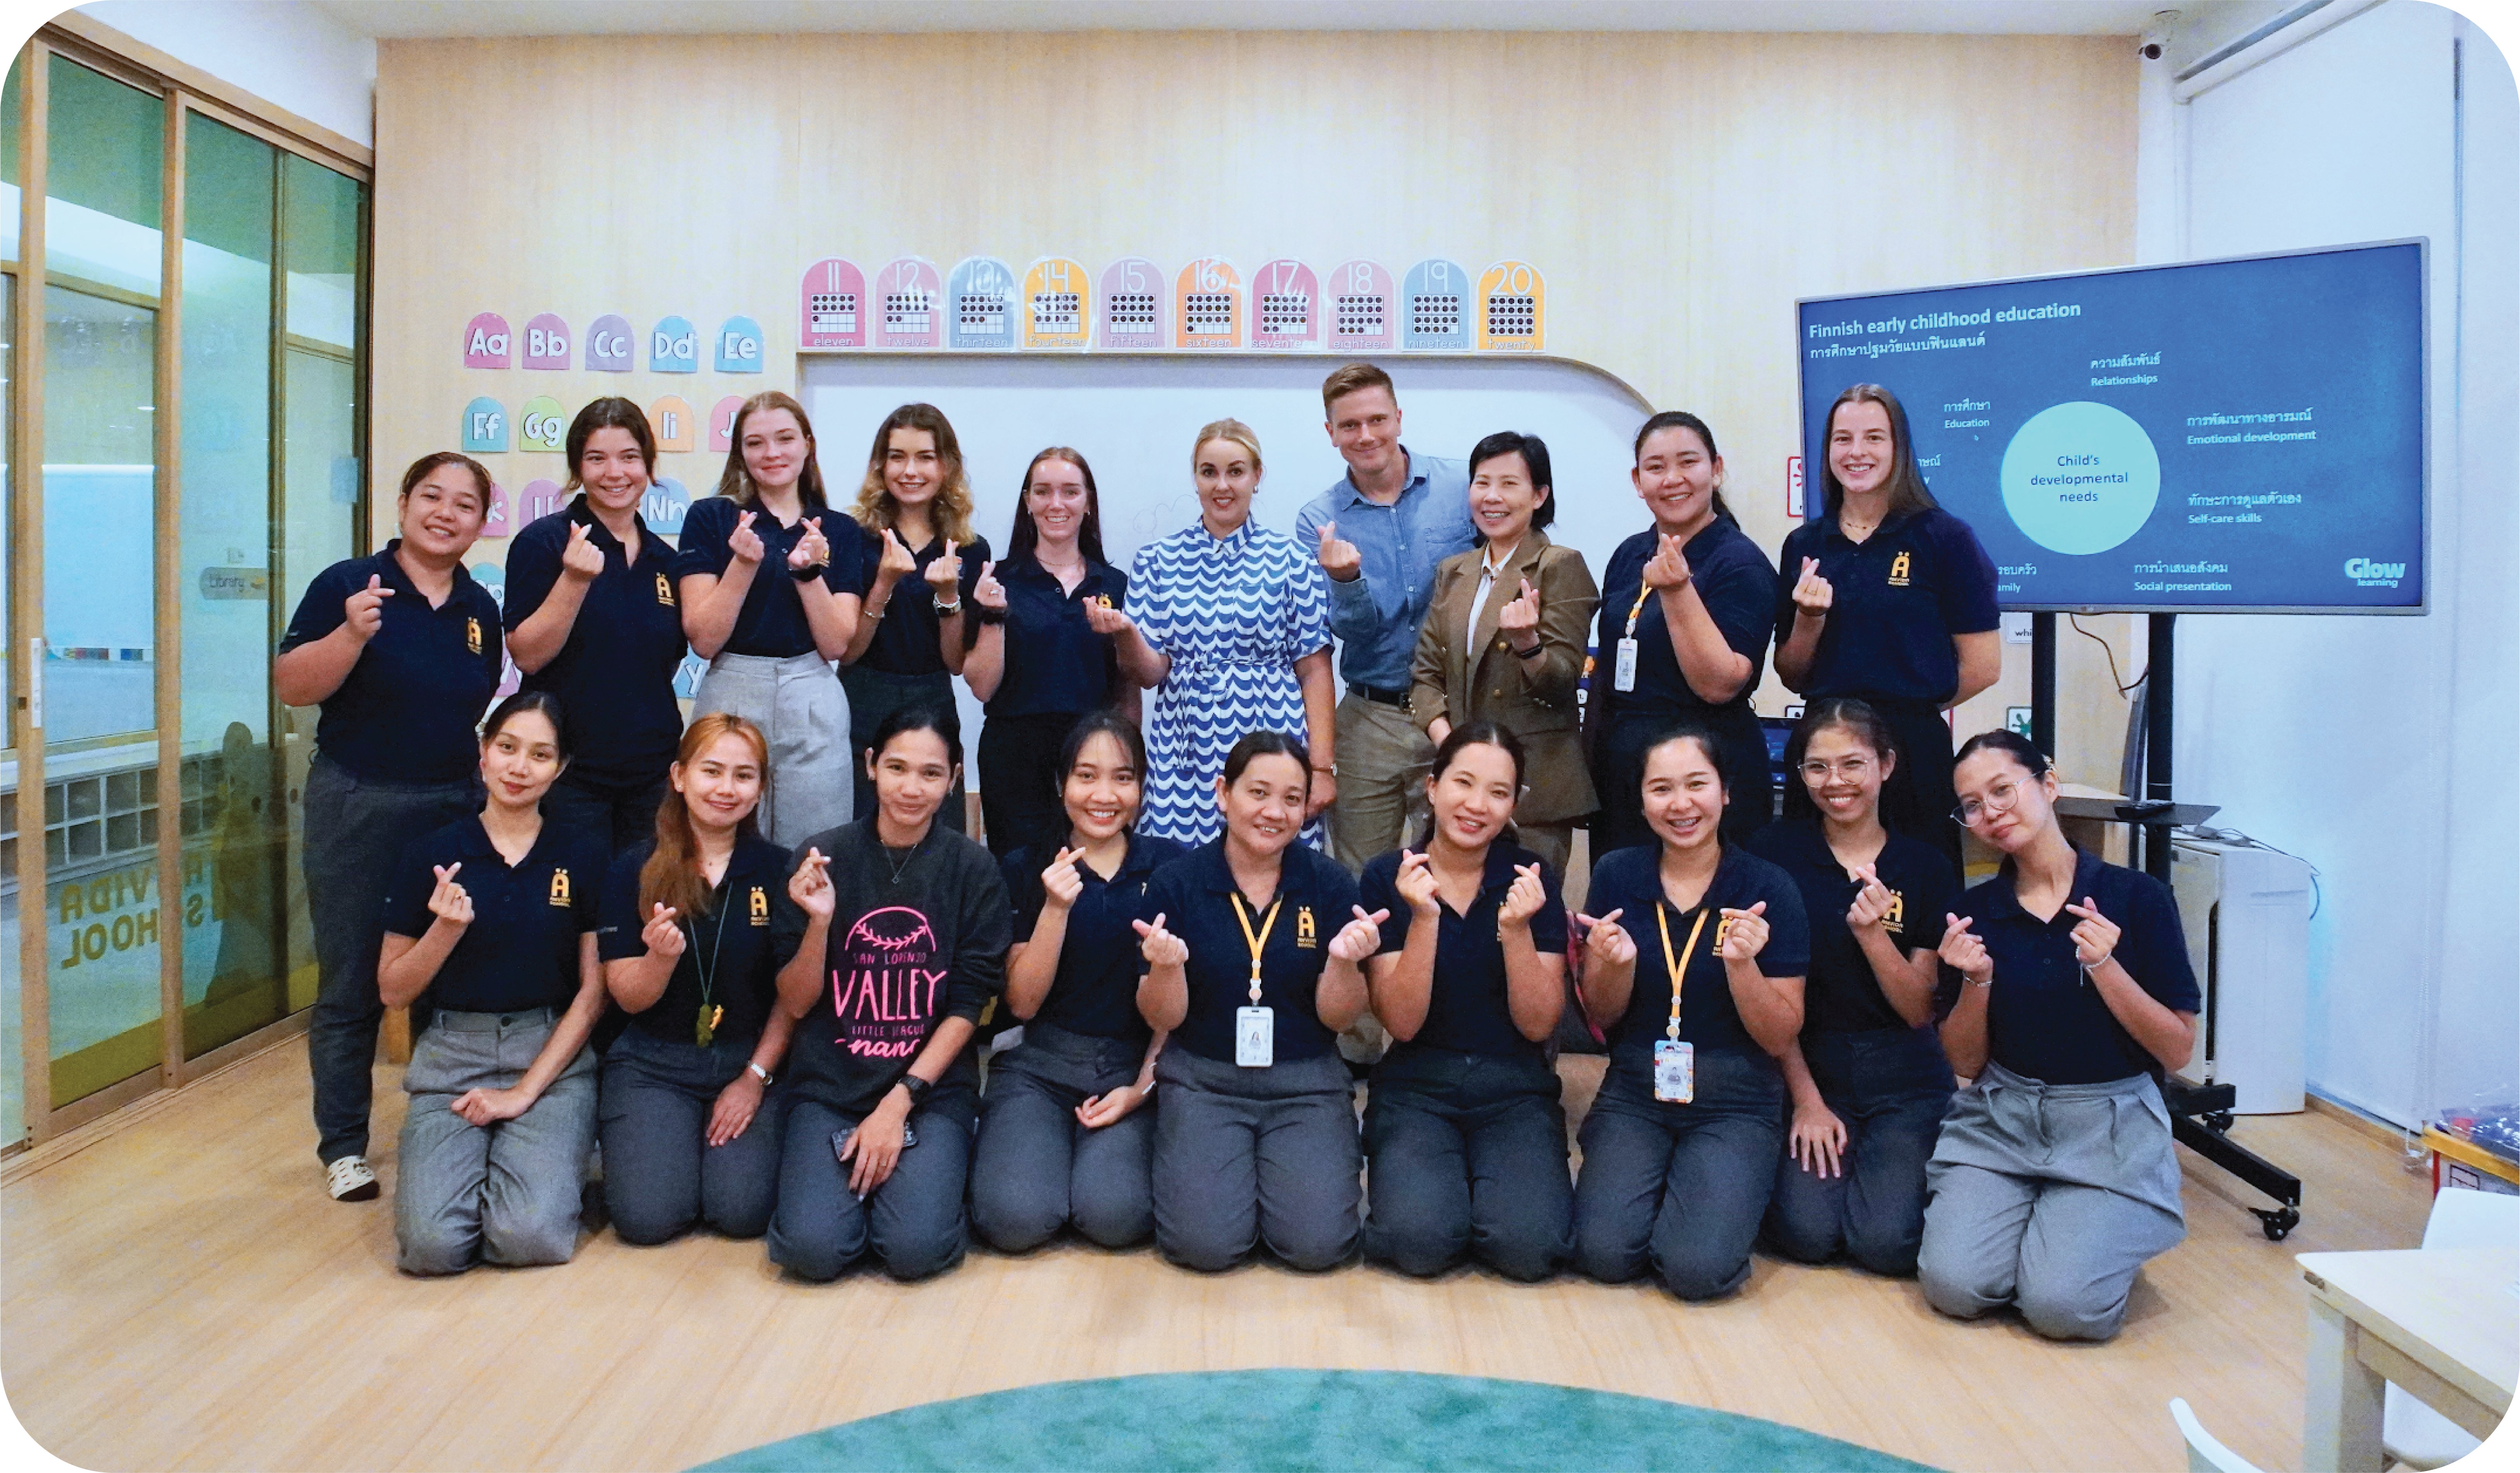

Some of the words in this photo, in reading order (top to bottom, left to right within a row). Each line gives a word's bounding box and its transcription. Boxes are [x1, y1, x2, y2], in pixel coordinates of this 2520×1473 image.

[894, 262, 920, 293] 12
[1044, 262, 1069, 293] 14
[1120, 262, 1146, 293] 15
[1194, 262, 1221, 293] 16
[1272, 262, 1301, 293] 17
[1348, 263, 1373, 294] 18
[1423, 262, 1449, 293] 19
[1489, 264, 1533, 295] 20
[1809, 320, 1863, 339] Finnish
[1867, 317, 1906, 334] early
[1911, 309, 1991, 330] childhood
[1995, 303, 2081, 322] education
[469, 328, 508, 356] Aa
[528, 329, 567, 357] Bb
[593, 331, 627, 358] Cc
[654, 332, 695, 360] Dd
[724, 332, 757, 360] Ee
[813, 337, 854, 347] eleven
[887, 336, 929, 347] twelve
[956, 335, 1008, 347] thirteen
[1029, 334, 1085, 347] fourteen
[1110, 335, 1157, 347] fifteen
[1185, 337, 1232, 348] sixteen
[1333, 338, 1388, 351] eighteen
[1408, 337, 1464, 349] nineteen
[1486, 339, 1535, 351] twenty
[2091, 374, 2158, 387] Relationships
[1944, 398, 1991, 412] การศึกษา
[472, 413, 501, 440] Ff
[524, 413, 562, 447] Gg
[1944, 419, 1991, 429] Education
[2187, 433, 2242, 445] Emotional
[2243, 430, 2317, 444] development
[2057, 454, 2100, 467] Child's
[2030, 472, 2128, 486] developmental
[2059, 490, 2099, 502] needs
[647, 495, 687, 521] Nn
[2188, 514, 2234, 524] Self-care
[2236, 513, 2263, 523] skills
[2345, 558, 2406, 579] Glow
[2134, 581, 2164, 591] Social
[2165, 581, 2233, 594] presentation
[2358, 579, 2398, 589] learning
[853, 953, 876, 964] SAN
[832, 969, 947, 1021] VALLEY
[852, 1025, 885, 1037] LITTLE
[892, 1023, 924, 1037] LEAGUE
